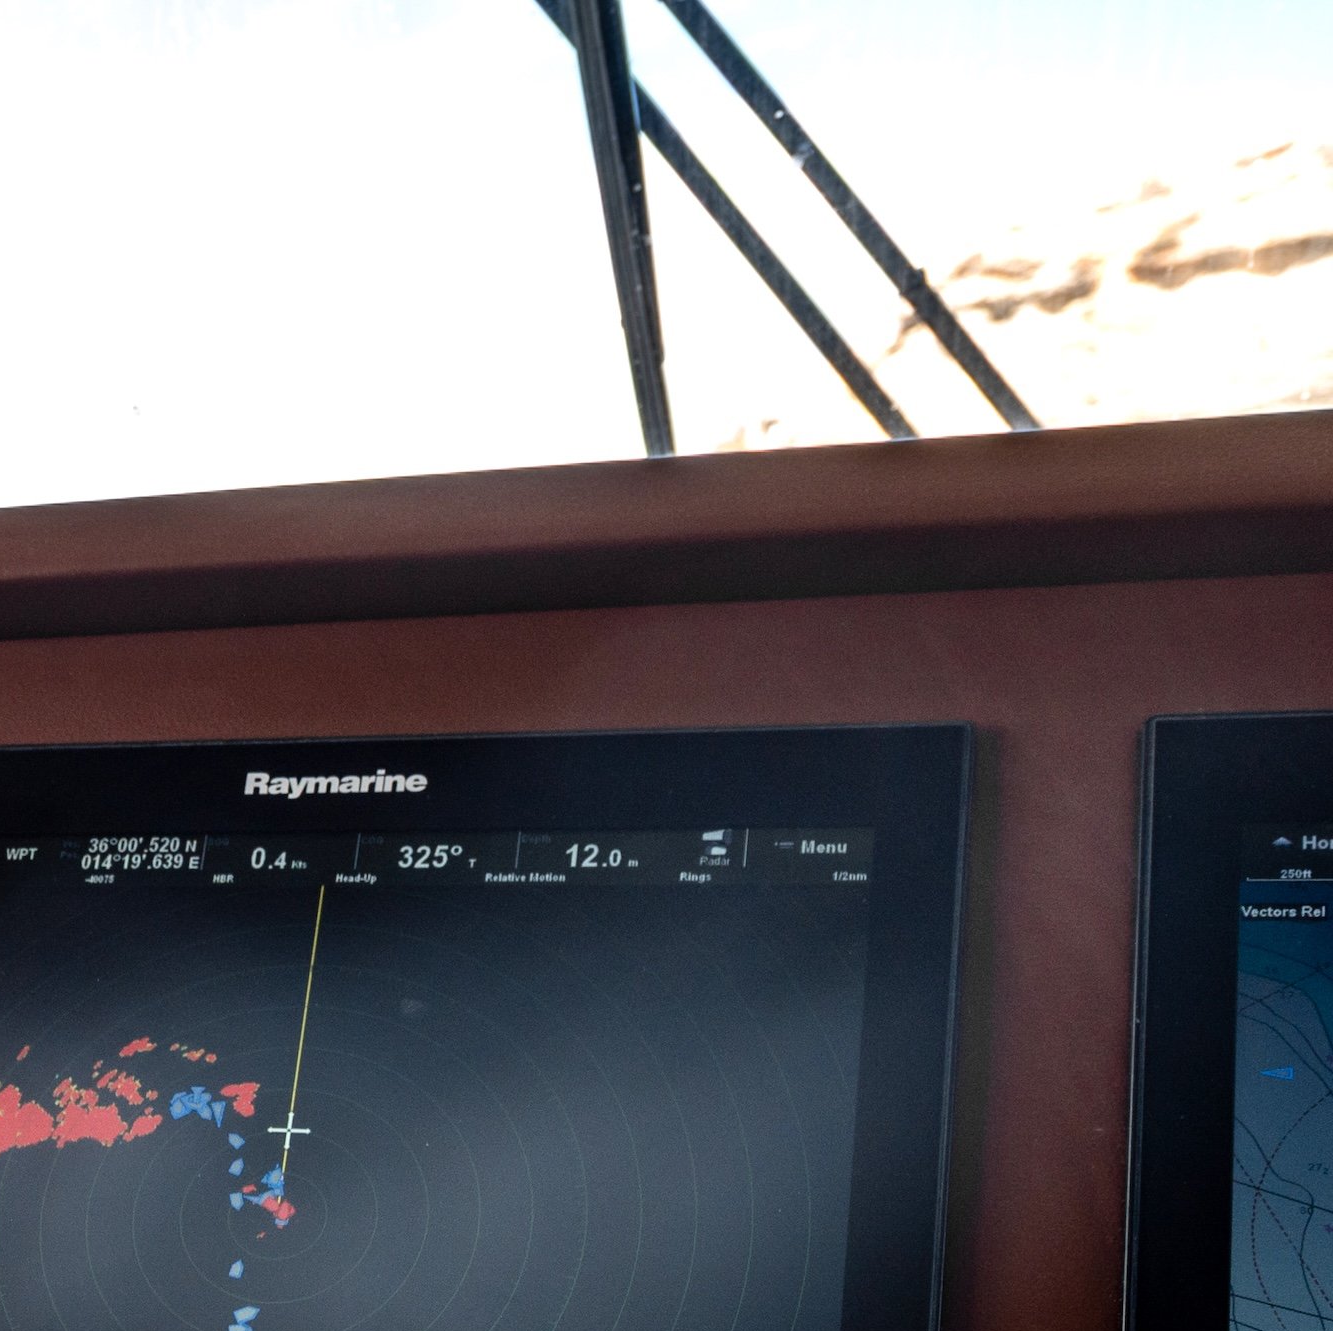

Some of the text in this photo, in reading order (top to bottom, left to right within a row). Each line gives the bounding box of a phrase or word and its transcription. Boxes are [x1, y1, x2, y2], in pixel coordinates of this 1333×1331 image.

[244, 769, 428, 799] Raymarine
[185, 840, 197, 852] N
[801, 840, 848, 854] Menu
[1302, 835, 1333, 850] Ho
[6, 848, 38, 860] WPT
[251, 847, 287, 870] 0.4
[565, 843, 638, 868] 12.0 m
[188, 856, 200, 869] E
[335, 873, 377, 885] Head-Up
[485, 872, 566, 883] Relative Motion
[679, 872, 712, 884] Rings
[1280, 869, 1312, 879] 250ft
[1240, 905, 1326, 918] Vectors Rel
